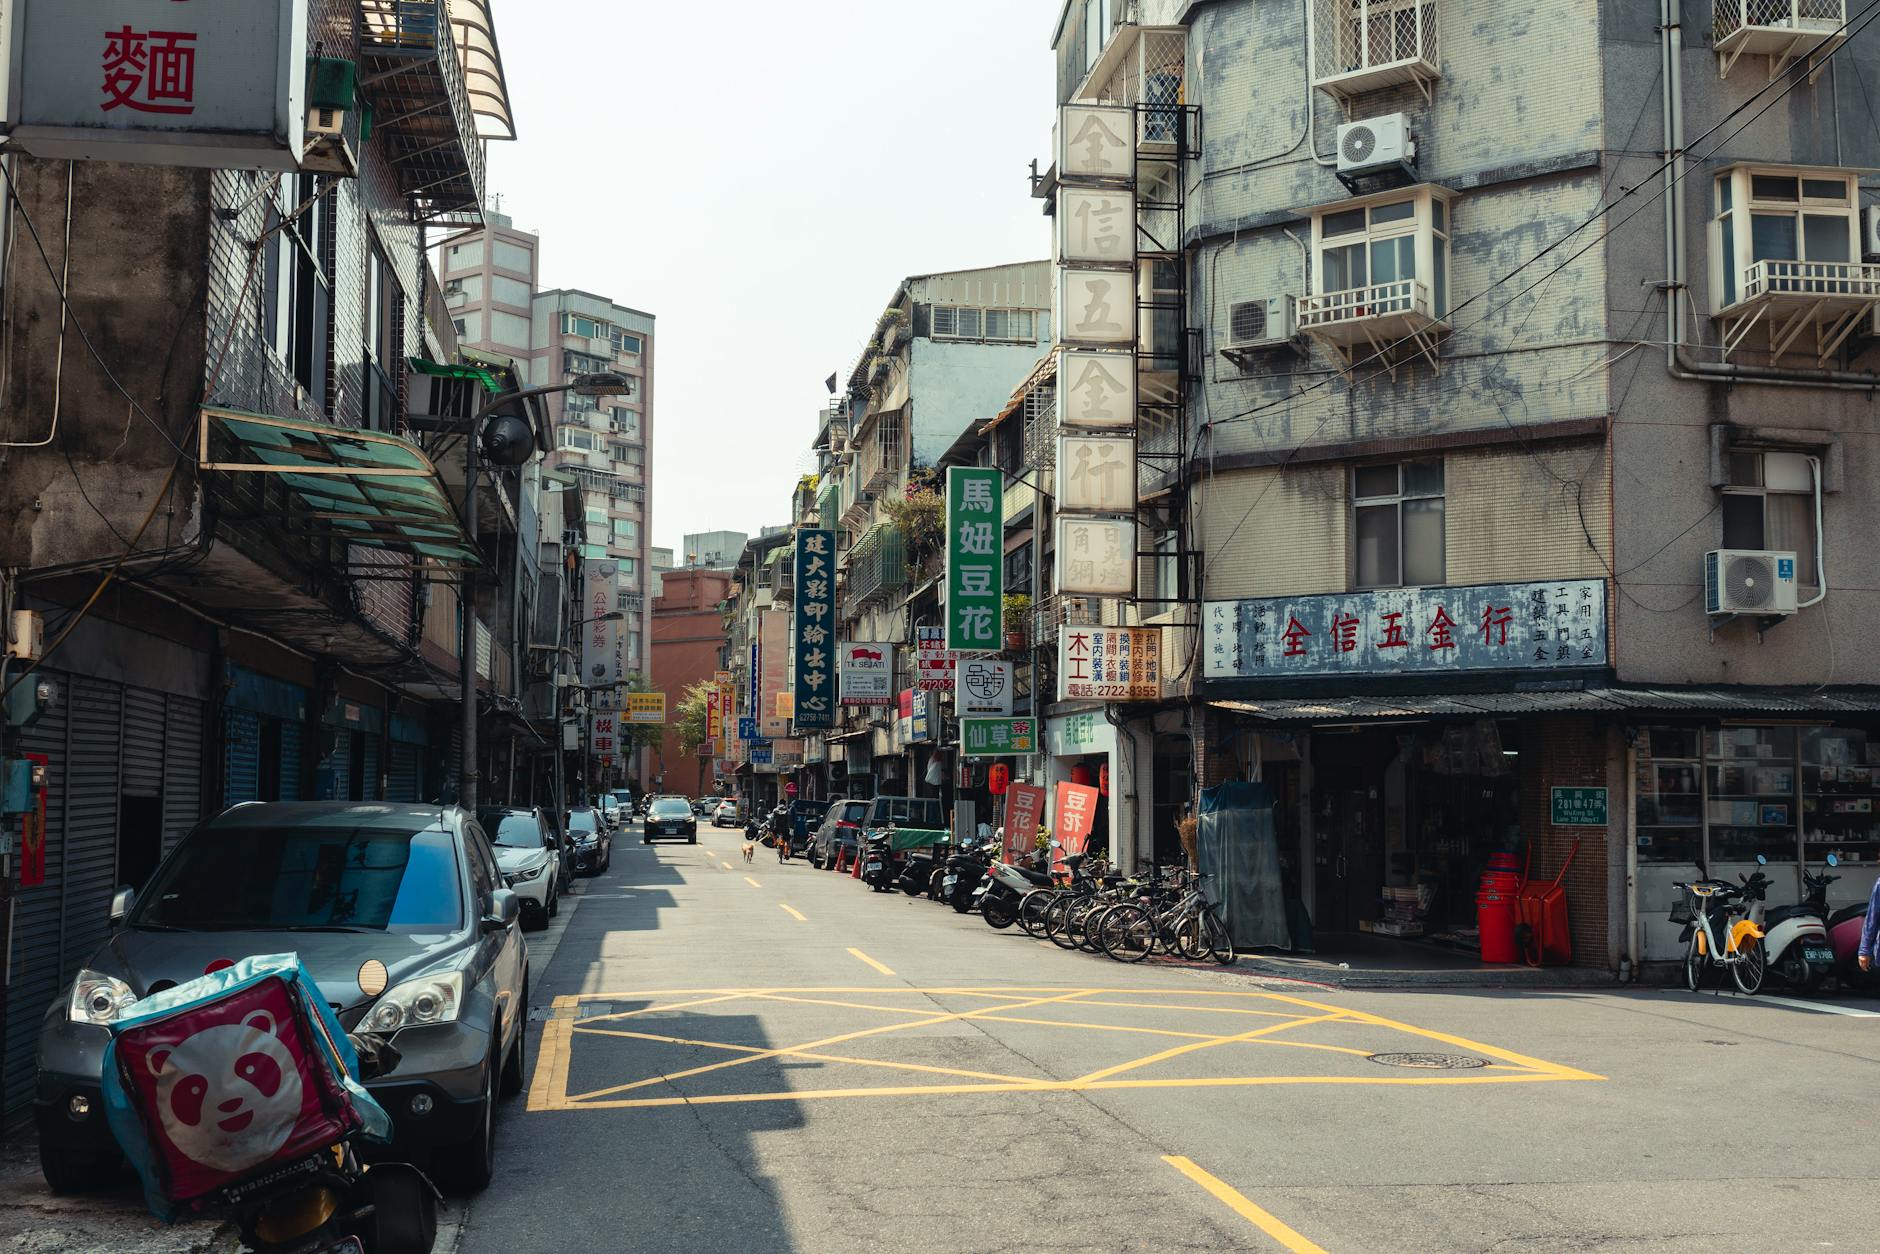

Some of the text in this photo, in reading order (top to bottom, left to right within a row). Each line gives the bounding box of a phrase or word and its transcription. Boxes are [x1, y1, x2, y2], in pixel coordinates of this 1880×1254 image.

[100, 25, 198, 115] 麵
[957, 477, 995, 642] 馬妞豆花
[801, 534, 829, 712] 建大影印輸出中心
[1281, 604, 1512, 657] 全信五金行
[1068, 632, 1089, 679] 木工
[1092, 632, 1103, 682] 室內裝潢
[919, 679, 955, 690] 2720-2
[595, 719, 613, 750] 機車
[968, 724, 1010, 749] 仙草
[1011, 790, 1036, 860] 豆花仙
